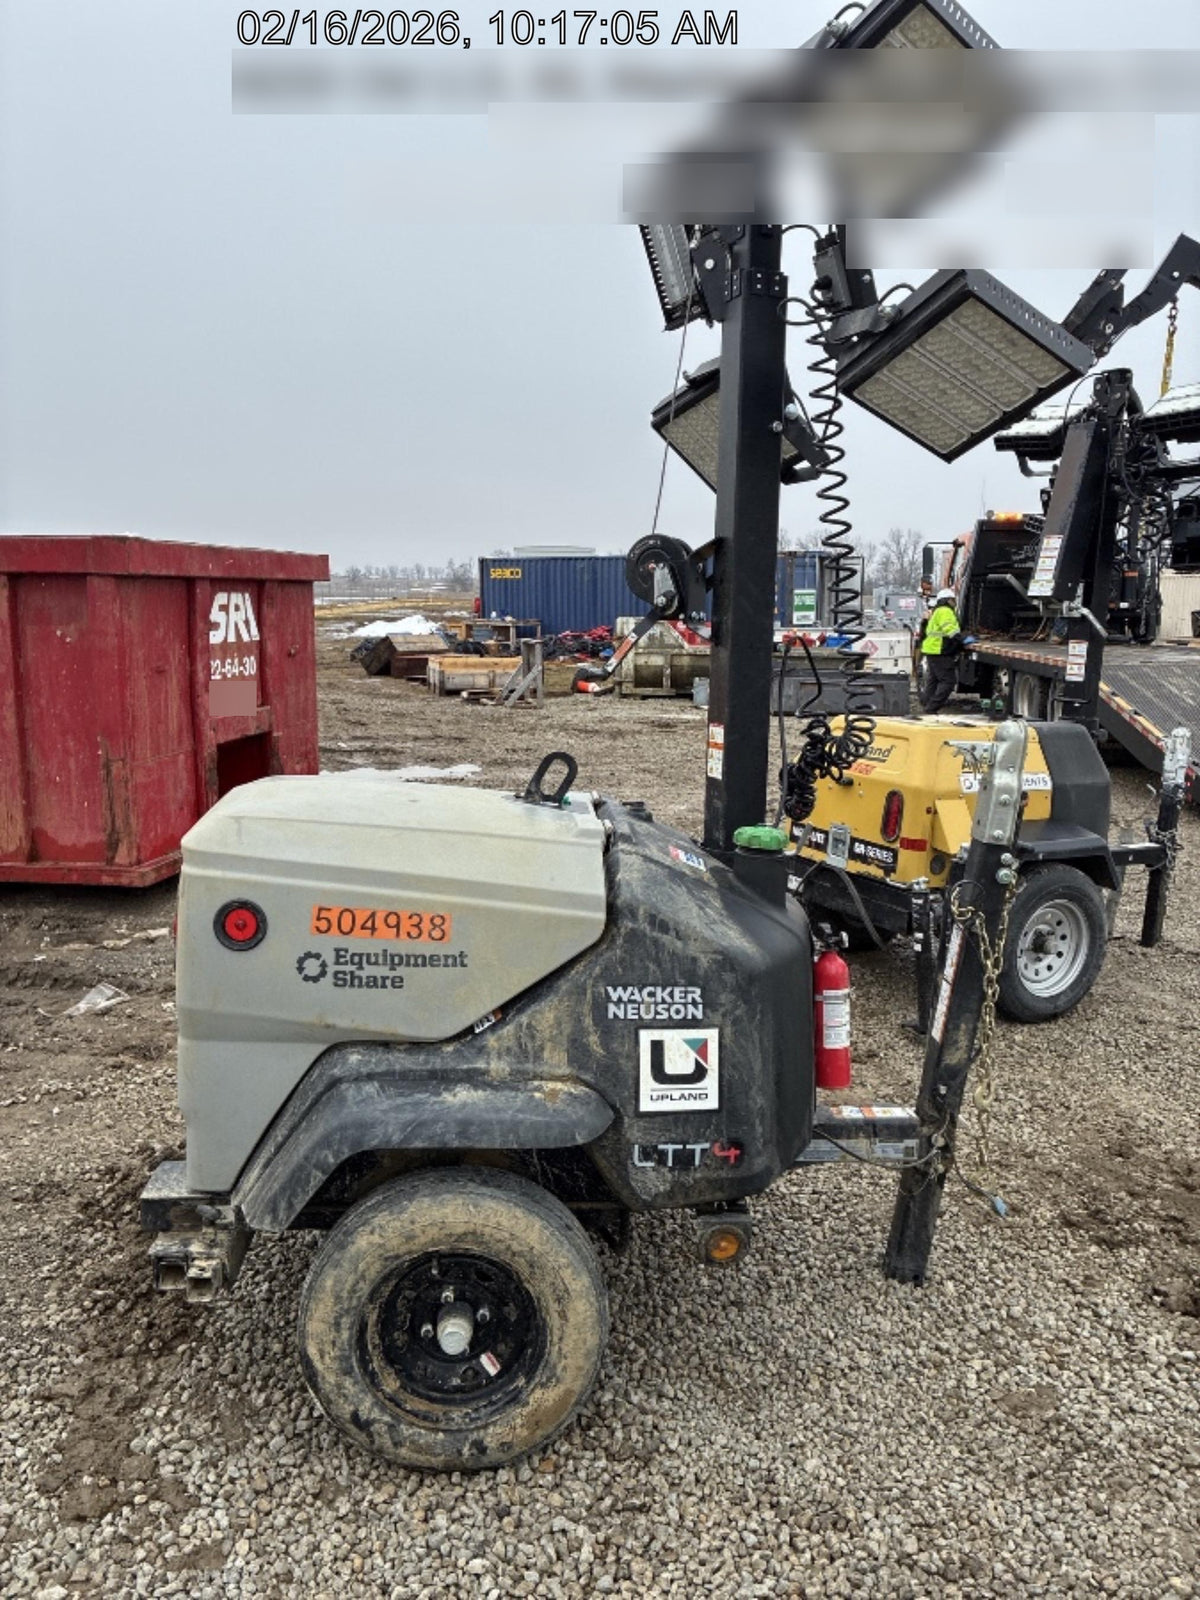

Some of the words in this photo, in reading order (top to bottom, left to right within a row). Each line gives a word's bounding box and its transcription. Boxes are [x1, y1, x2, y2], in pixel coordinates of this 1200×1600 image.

[314, 907, 447, 942] 504938
[333, 948, 469, 971] Equipment
[333, 970, 405, 989] Share
[606, 985, 704, 1004] WACKER
[607, 1002, 704, 1020] NEUSON
[650, 1092, 709, 1102] UPLAND
